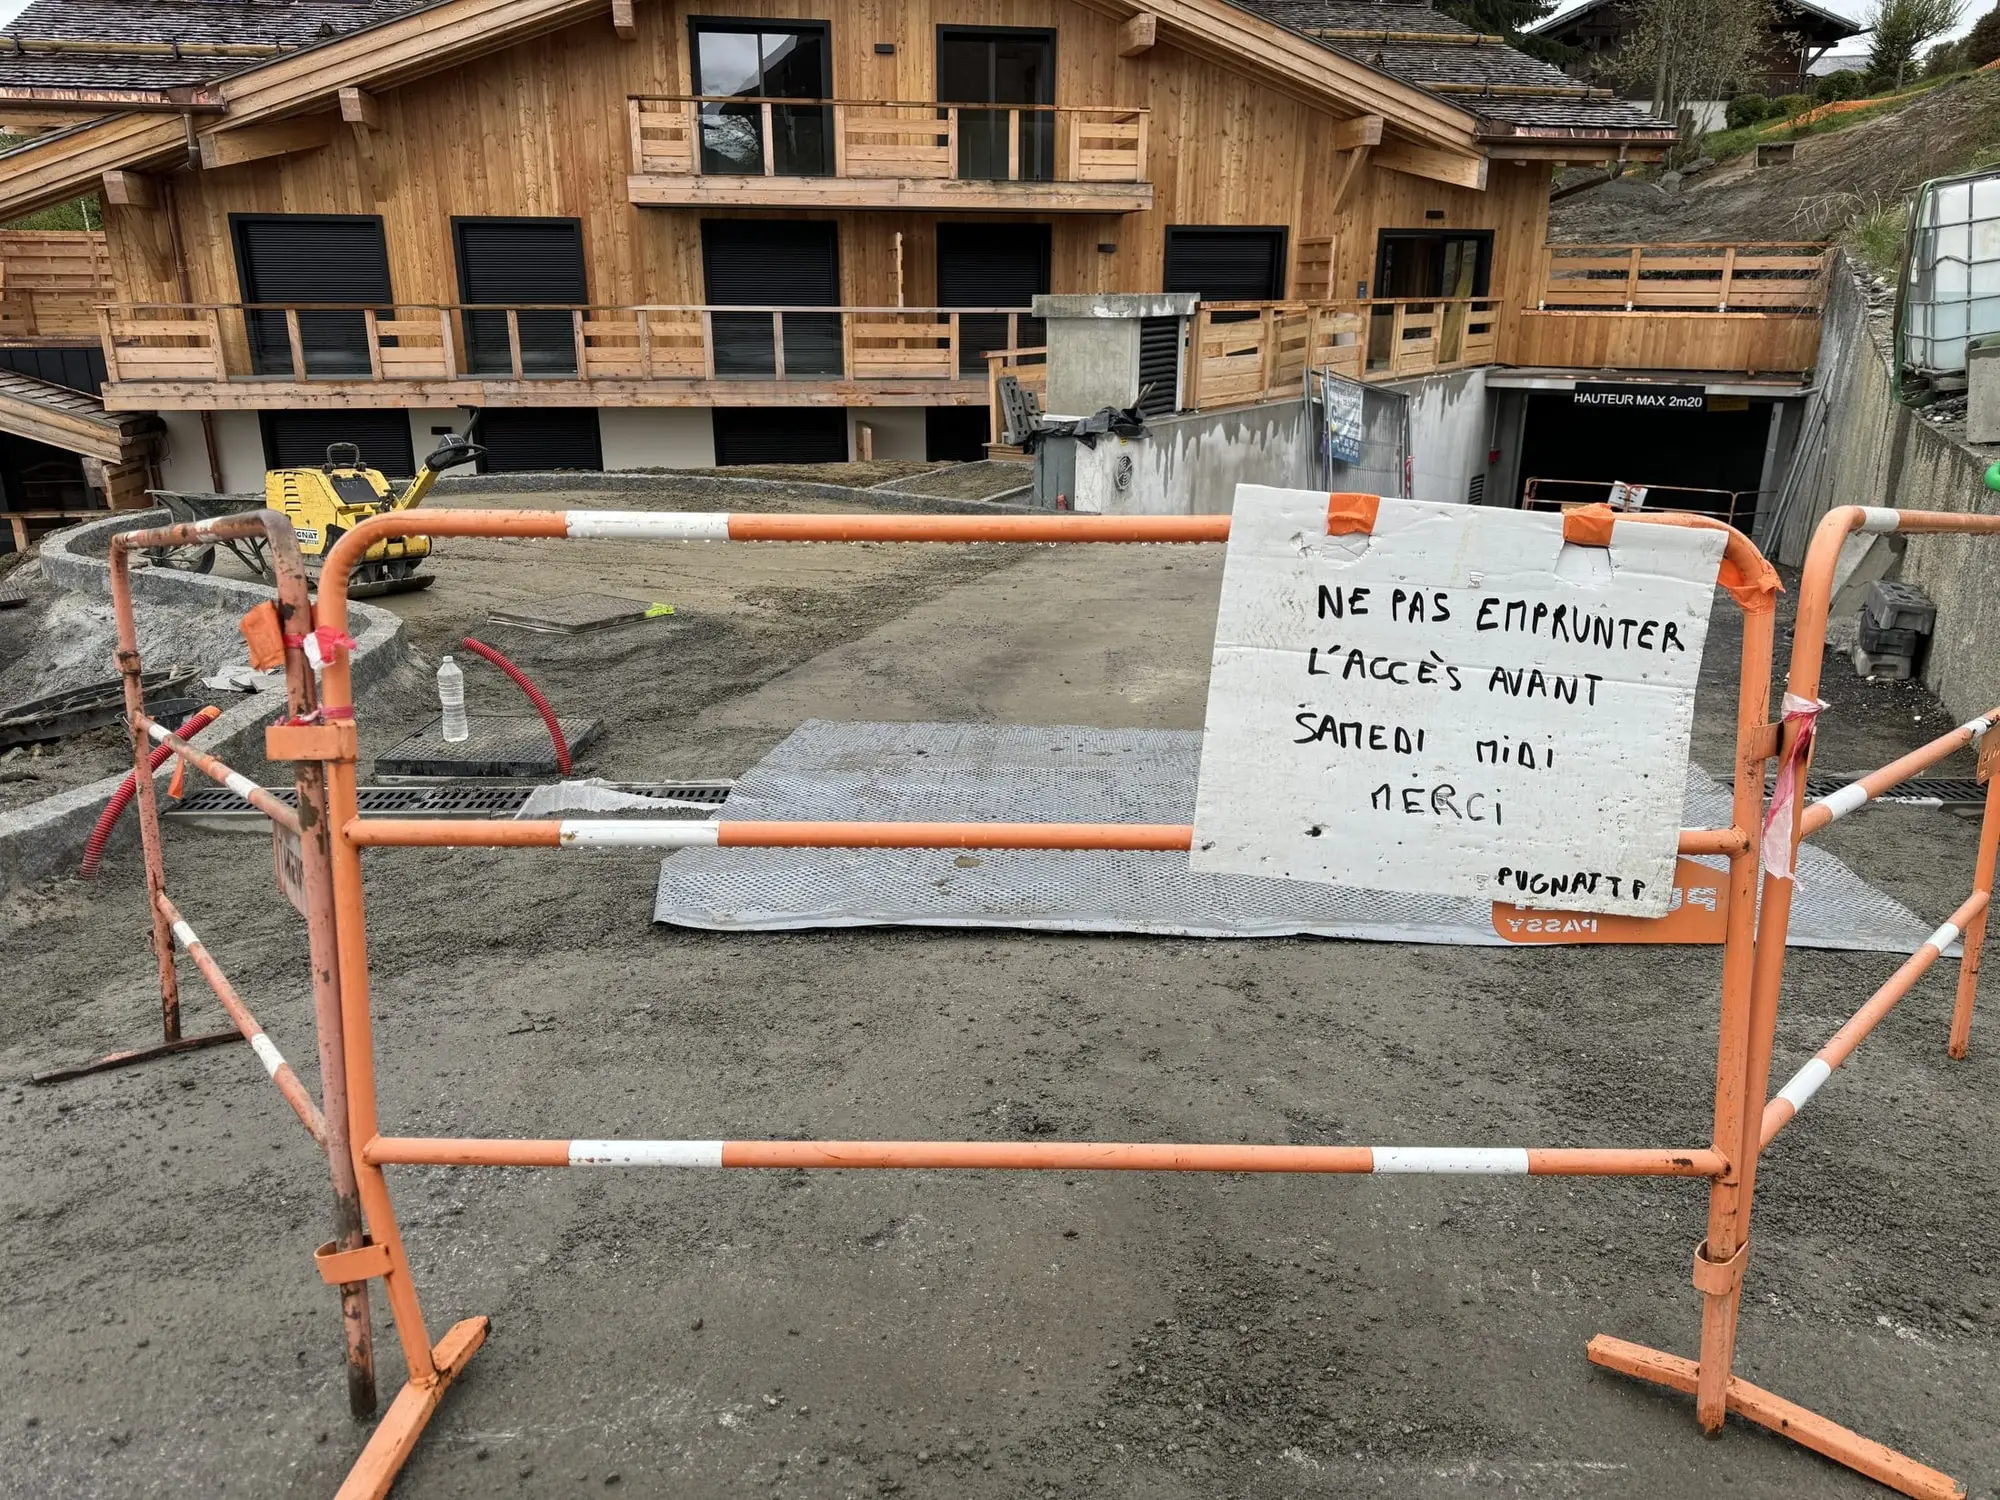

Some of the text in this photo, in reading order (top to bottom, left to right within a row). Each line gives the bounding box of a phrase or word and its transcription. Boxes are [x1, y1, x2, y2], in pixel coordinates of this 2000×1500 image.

[1573, 392, 1703, 408] HAUTEUR MAX 2m20
[1317, 584, 1685, 653] NE PAS EMPRUNTER
[1308, 644, 1603, 706] L'ACCÈS AVANT
[1293, 712, 1425, 755] SAMEDI
